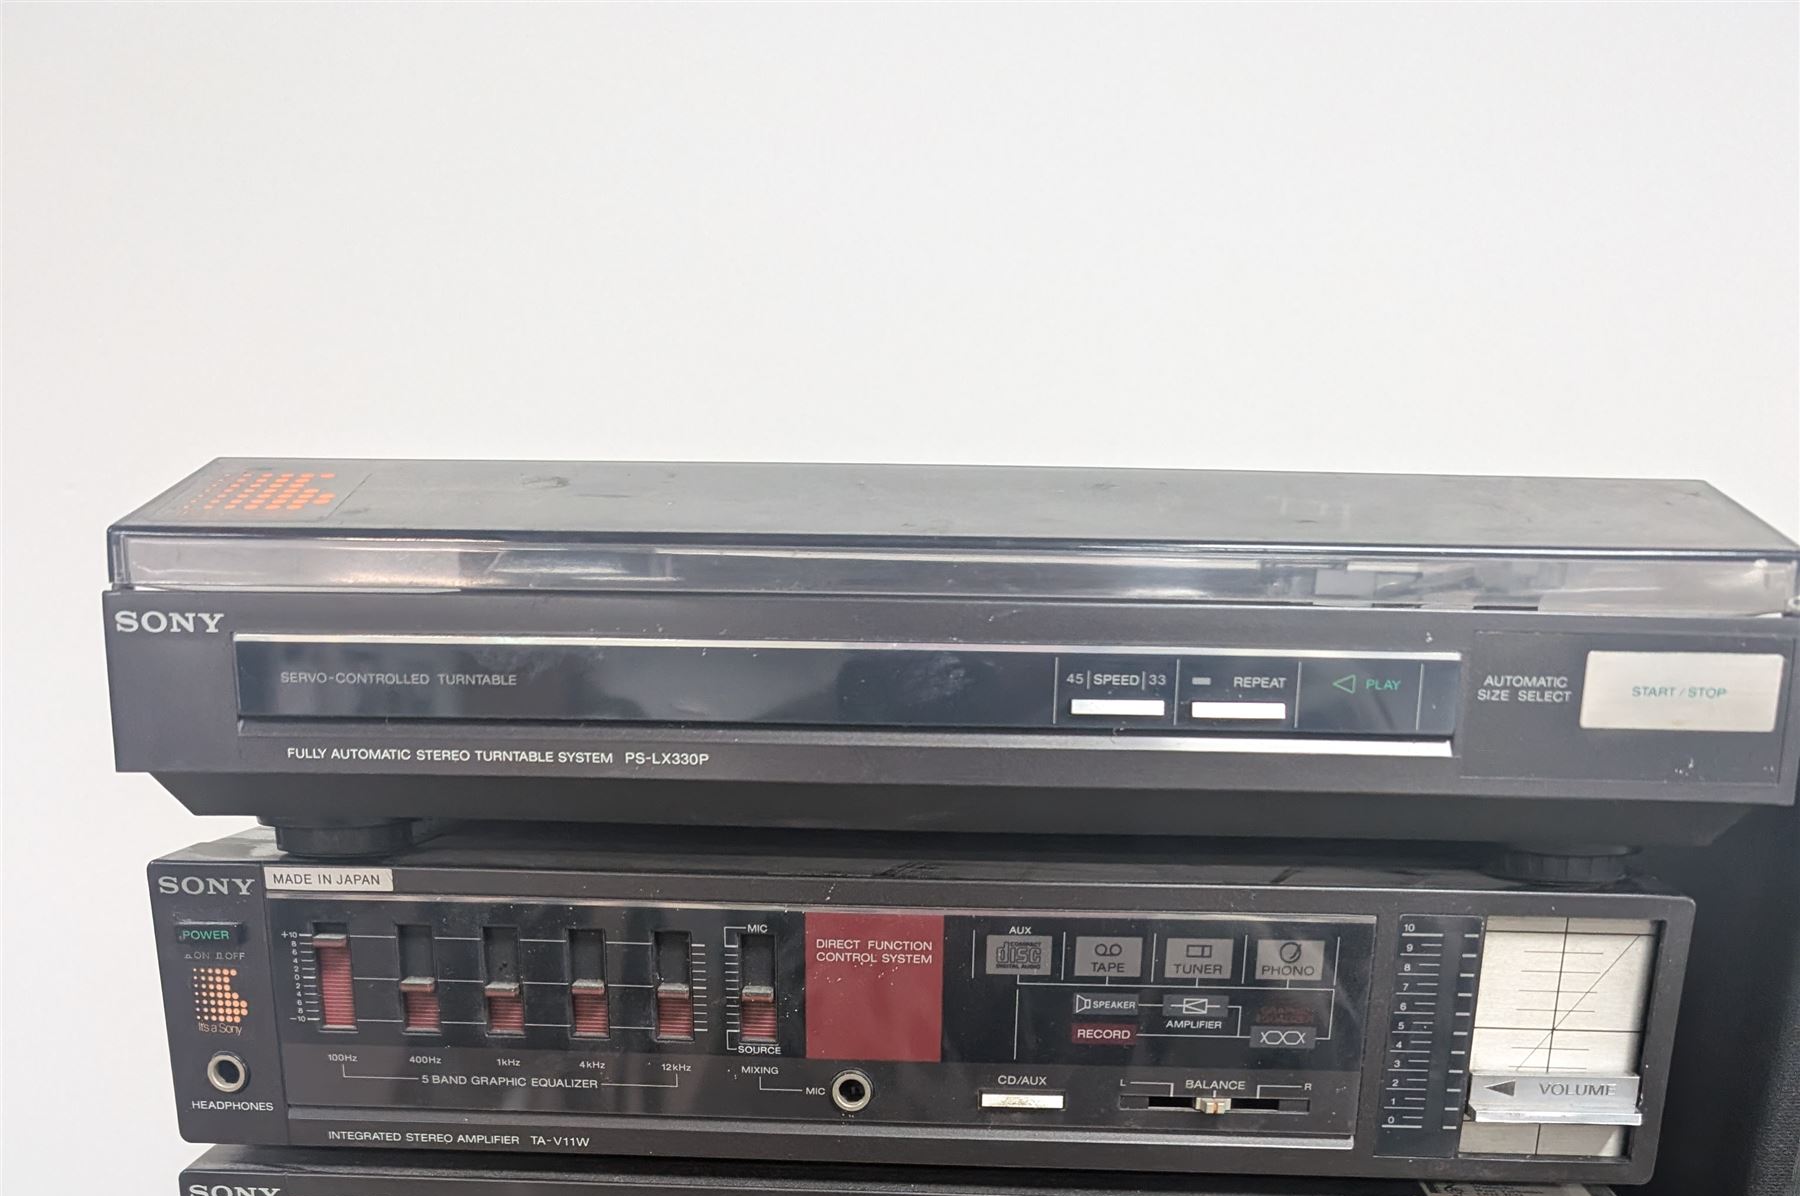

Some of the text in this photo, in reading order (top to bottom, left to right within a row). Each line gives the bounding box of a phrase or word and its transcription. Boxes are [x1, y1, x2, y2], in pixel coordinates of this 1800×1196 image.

[115, 611, 224, 633] SONY
[280, 672, 517, 687] SERVO-CONTROLLED TURNTABLE
[1066, 673, 1166, 687] 45 SPEED 33
[1233, 677, 1286, 689] REPEAT
[1366, 679, 1401, 691] PLAY
[1483, 675, 1569, 688] AUTOMATIC
[1477, 689, 1573, 703] SIZE SELECT
[287, 747, 709, 766] FULLY AUTOMATIC STEREO TURNTABLE SYSTEM PS-LX330P
[158, 876, 255, 895] SONY
[273, 874, 380, 886] MADE IN JAPAN
[747, 924, 768, 933] MIC
[1009, 926, 1031, 934] AUX
[1404, 923, 1416, 932] 10
[182, 930, 230, 940] POWER
[816, 939, 933, 951] DIRECT FUNCTION
[816, 952, 932, 964] CONTROL SYSTEM
[1091, 962, 1125, 973] TAPE
[1174, 963, 1223, 975] TUNER
[1261, 965, 1315, 976] PHONO
[1092, 1000, 1136, 1010] SPEAKER
[1165, 1020, 1222, 1030] AMPLIFIER
[1077, 1029, 1131, 1040] RECORD
[738, 1045, 781, 1055] SOURCE
[327, 1054, 358, 1063] 100Hz
[409, 1055, 442, 1065] 400Hz
[496, 1058, 520, 1068] 1kHz
[579, 1060, 605, 1070] 4kHz
[661, 1063, 691, 1073] 12kHz
[741, 1065, 779, 1075] MIXING
[421, 1075, 598, 1089] 5 BAND GRAPHIC EQUALIZER
[997, 1075, 1047, 1086] CD/AUX
[1185, 1079, 1246, 1090] BALANCE
[805, 1087, 826, 1096] MIC
[1539, 1083, 1617, 1097] VOLUME
[192, 1101, 274, 1111] HEADPHONES
[329, 1131, 590, 1147] INTEGRATED STEREO AMPLIFIER TA-V11W
